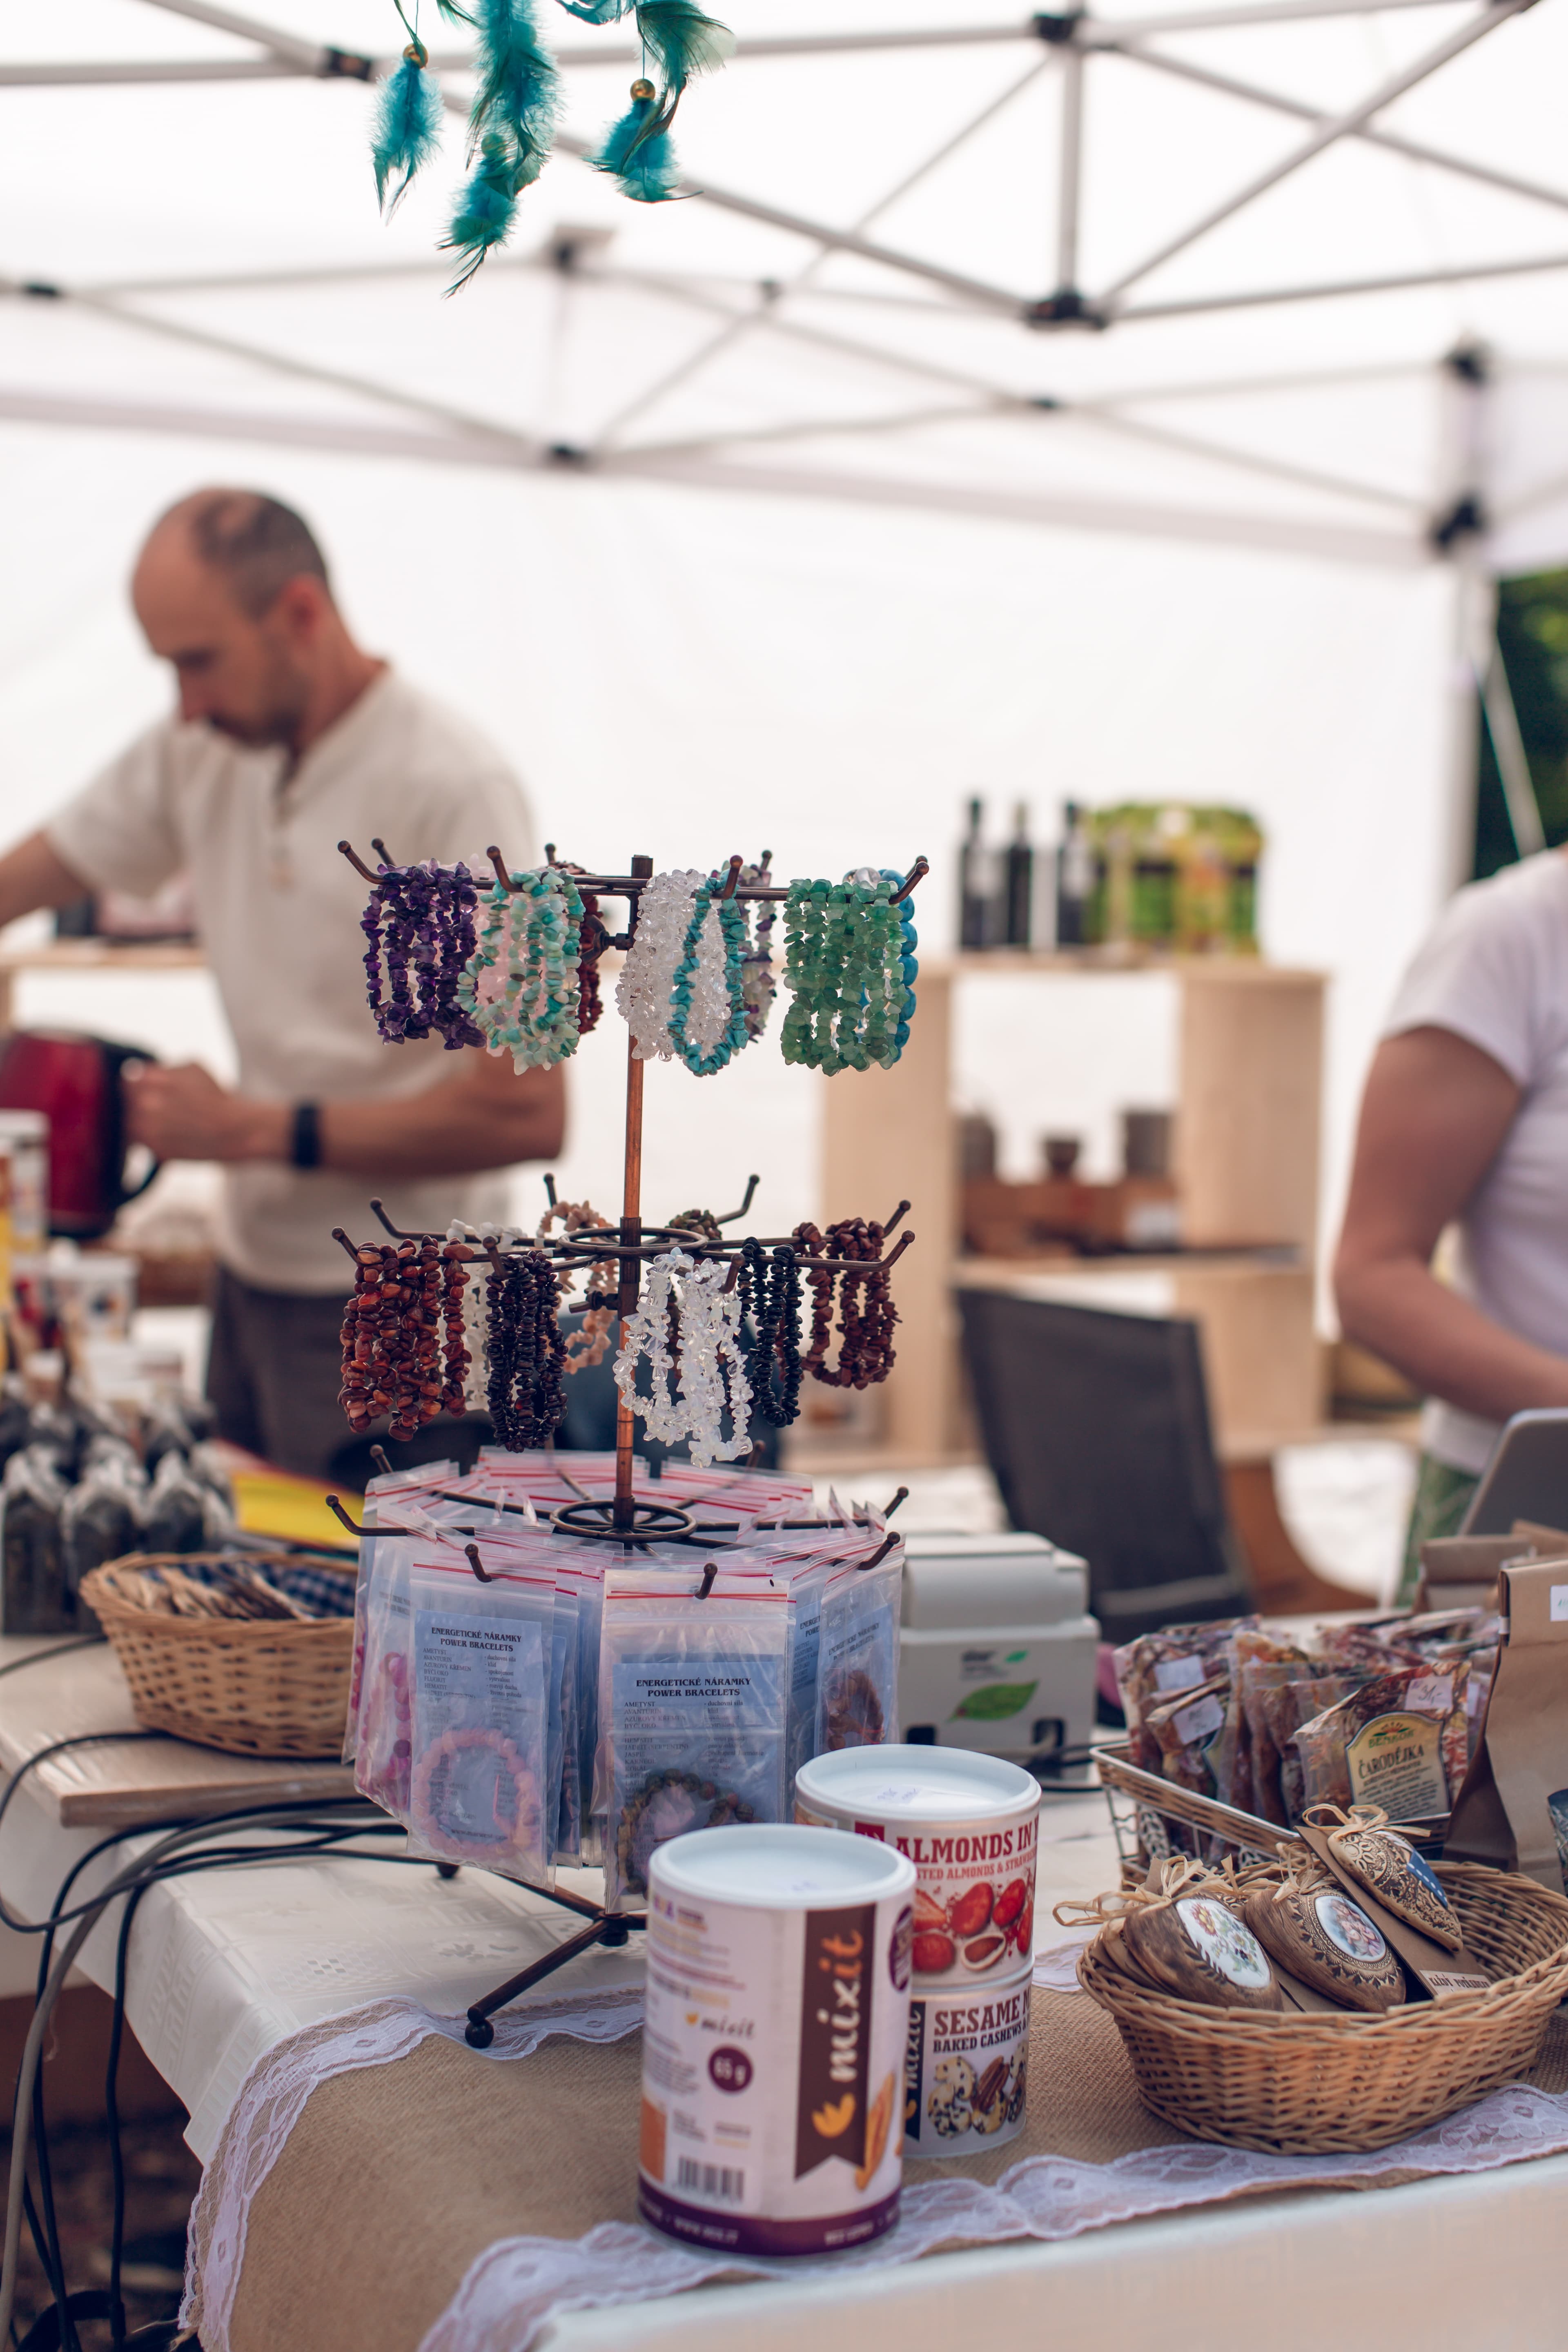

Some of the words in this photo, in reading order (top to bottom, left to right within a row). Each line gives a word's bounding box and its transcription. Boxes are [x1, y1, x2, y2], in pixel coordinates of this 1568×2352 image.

[432, 1627, 482, 1639] ENERGETICKÉ
[484, 1632, 521, 1642] NÁRAMKY
[441, 1638, 467, 1647] POWER
[470, 1641, 513, 1652] BRACELETS
[636, 1677, 701, 1687] ENERGETICKÉ
[705, 1677, 751, 1686] NÁRAMKY
[896, 1829, 1013, 1863] ALMONDS
[1018, 1821, 1032, 1851] IN
[947, 1863, 994, 1879] ALMONDS
[817, 1929, 864, 2082] mixit
[934, 1994, 1020, 2036] SESAME
[933, 2036, 977, 2054] BAKED
[980, 2020, 1021, 2048] CASHEWS
